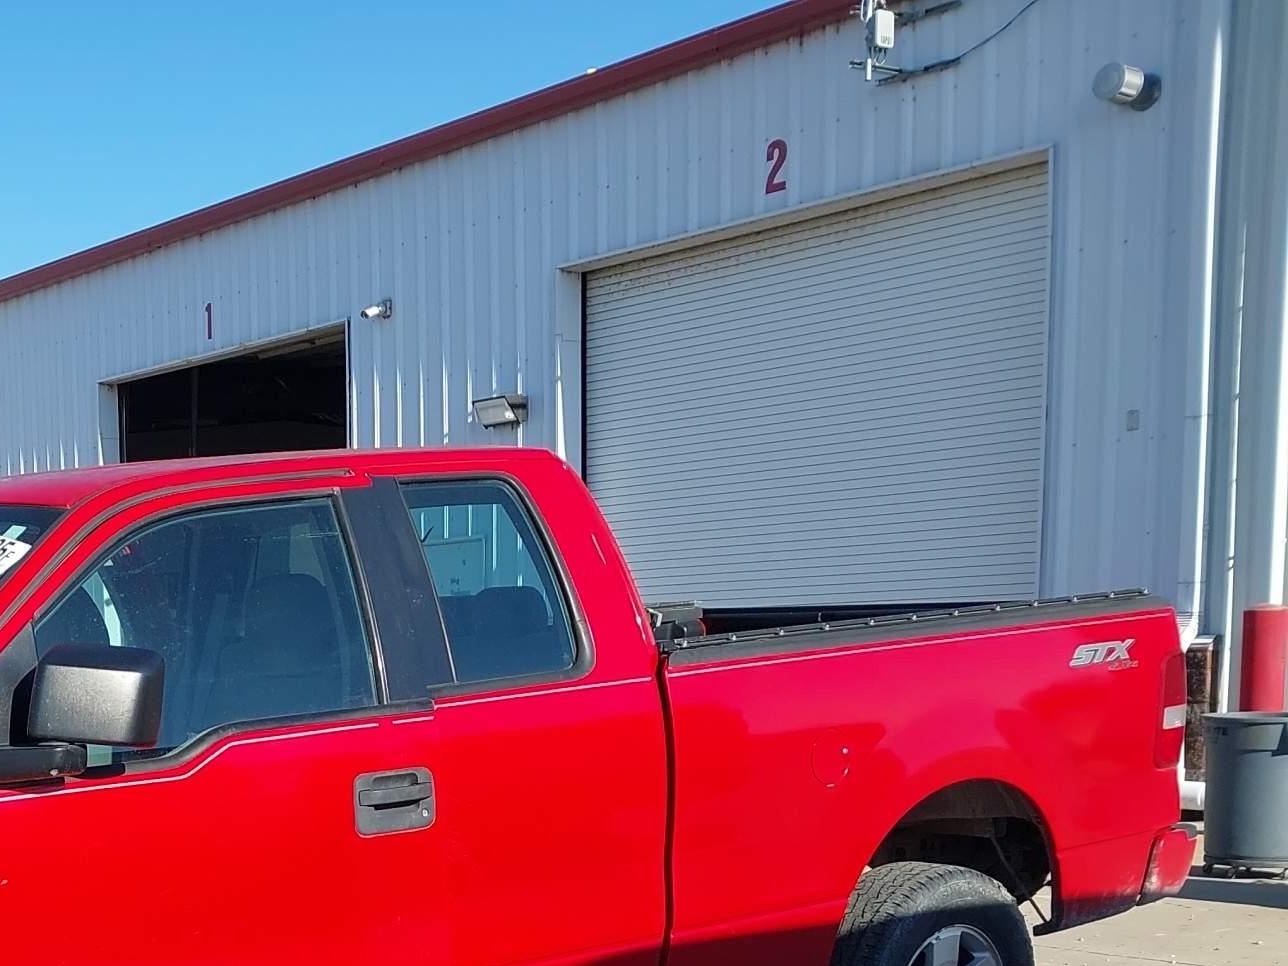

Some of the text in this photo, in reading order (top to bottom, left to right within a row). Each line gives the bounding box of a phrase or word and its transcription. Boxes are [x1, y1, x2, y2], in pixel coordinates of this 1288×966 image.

[765, 139, 788, 194] 2
[205, 302, 212, 340] 1
[1069, 639, 1136, 668] STX
